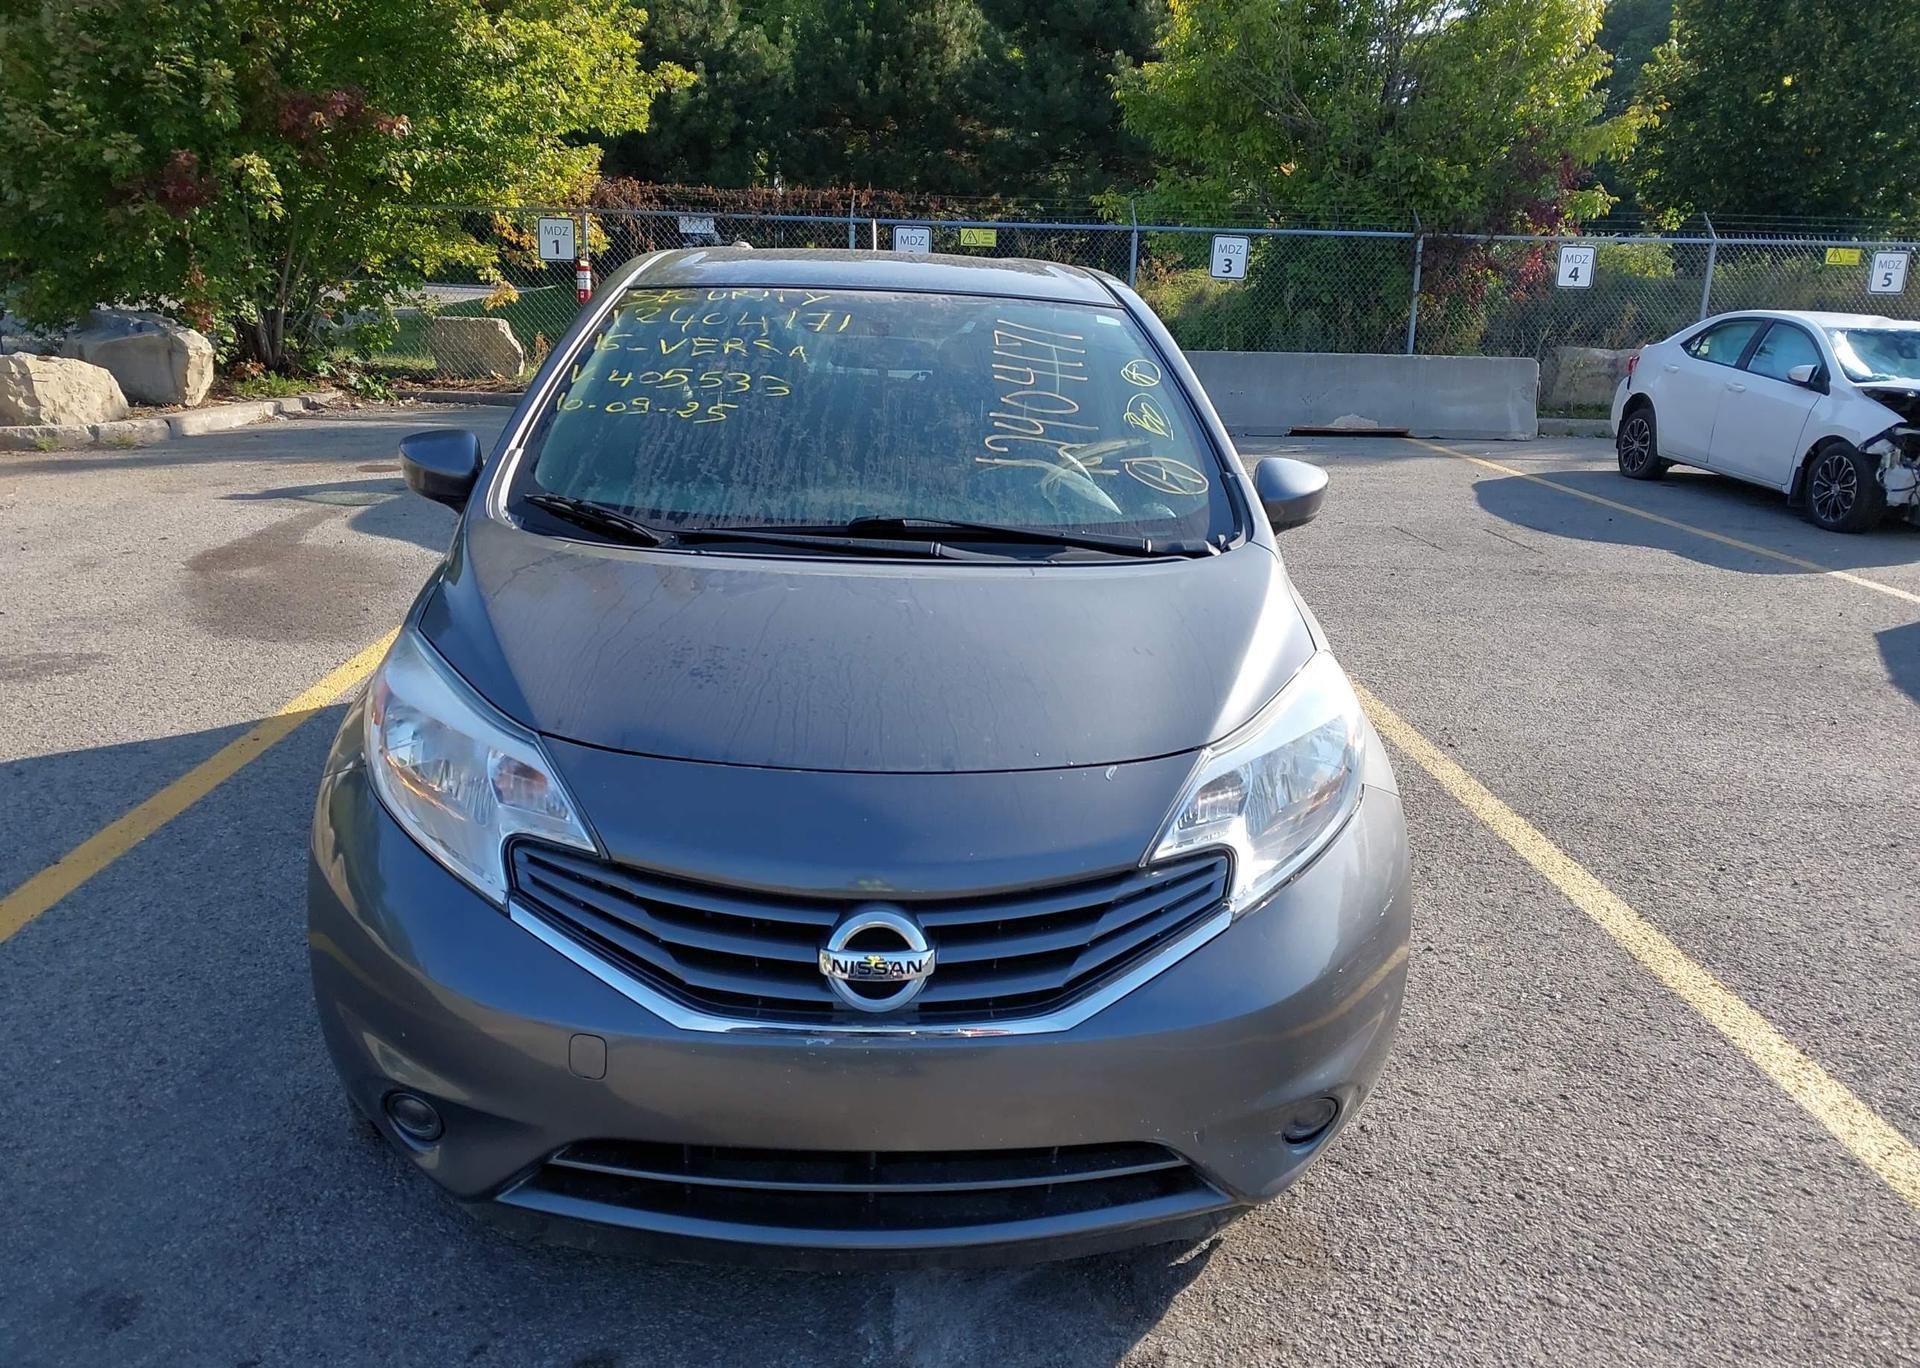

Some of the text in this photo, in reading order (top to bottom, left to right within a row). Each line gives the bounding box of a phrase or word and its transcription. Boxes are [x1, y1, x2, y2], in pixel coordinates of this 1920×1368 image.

[543, 225, 569, 236] MDZ
[552, 239, 560, 255] 1
[900, 234, 925, 246] MDZ
[1217, 243, 1243, 255] MDZ
[1222, 258, 1233, 273] 3
[1564, 253, 1590, 265] MDZ
[1878, 260, 1903, 270] MDZ
[1568, 266, 1580, 281] 4
[1881, 272, 1893, 287] 5
[613, 308, 850, 337] 12404171
[831, 958, 923, 976] NISSAN
